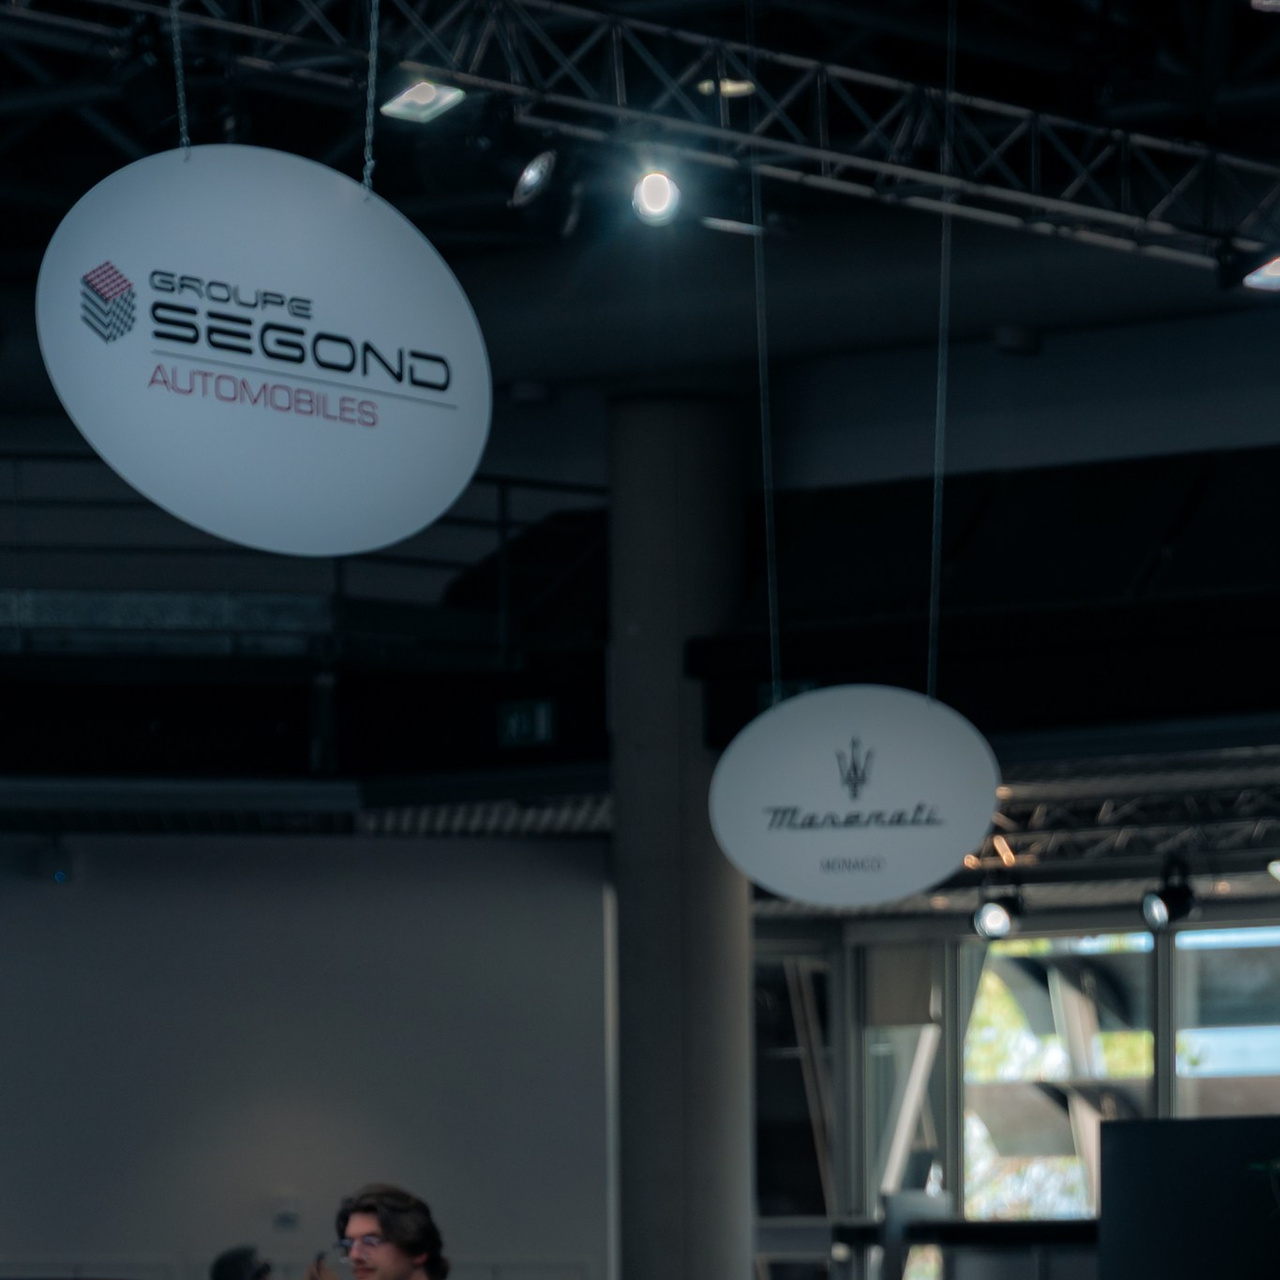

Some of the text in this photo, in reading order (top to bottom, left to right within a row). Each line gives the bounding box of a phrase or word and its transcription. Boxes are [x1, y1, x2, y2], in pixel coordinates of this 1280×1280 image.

[148, 269, 314, 321] GROUPE
[150, 301, 451, 393] SEGOND
[147, 363, 379, 428] AUTOMOBILES
[765, 803, 945, 829] Maserati
[819, 856, 886, 874] MONACO
